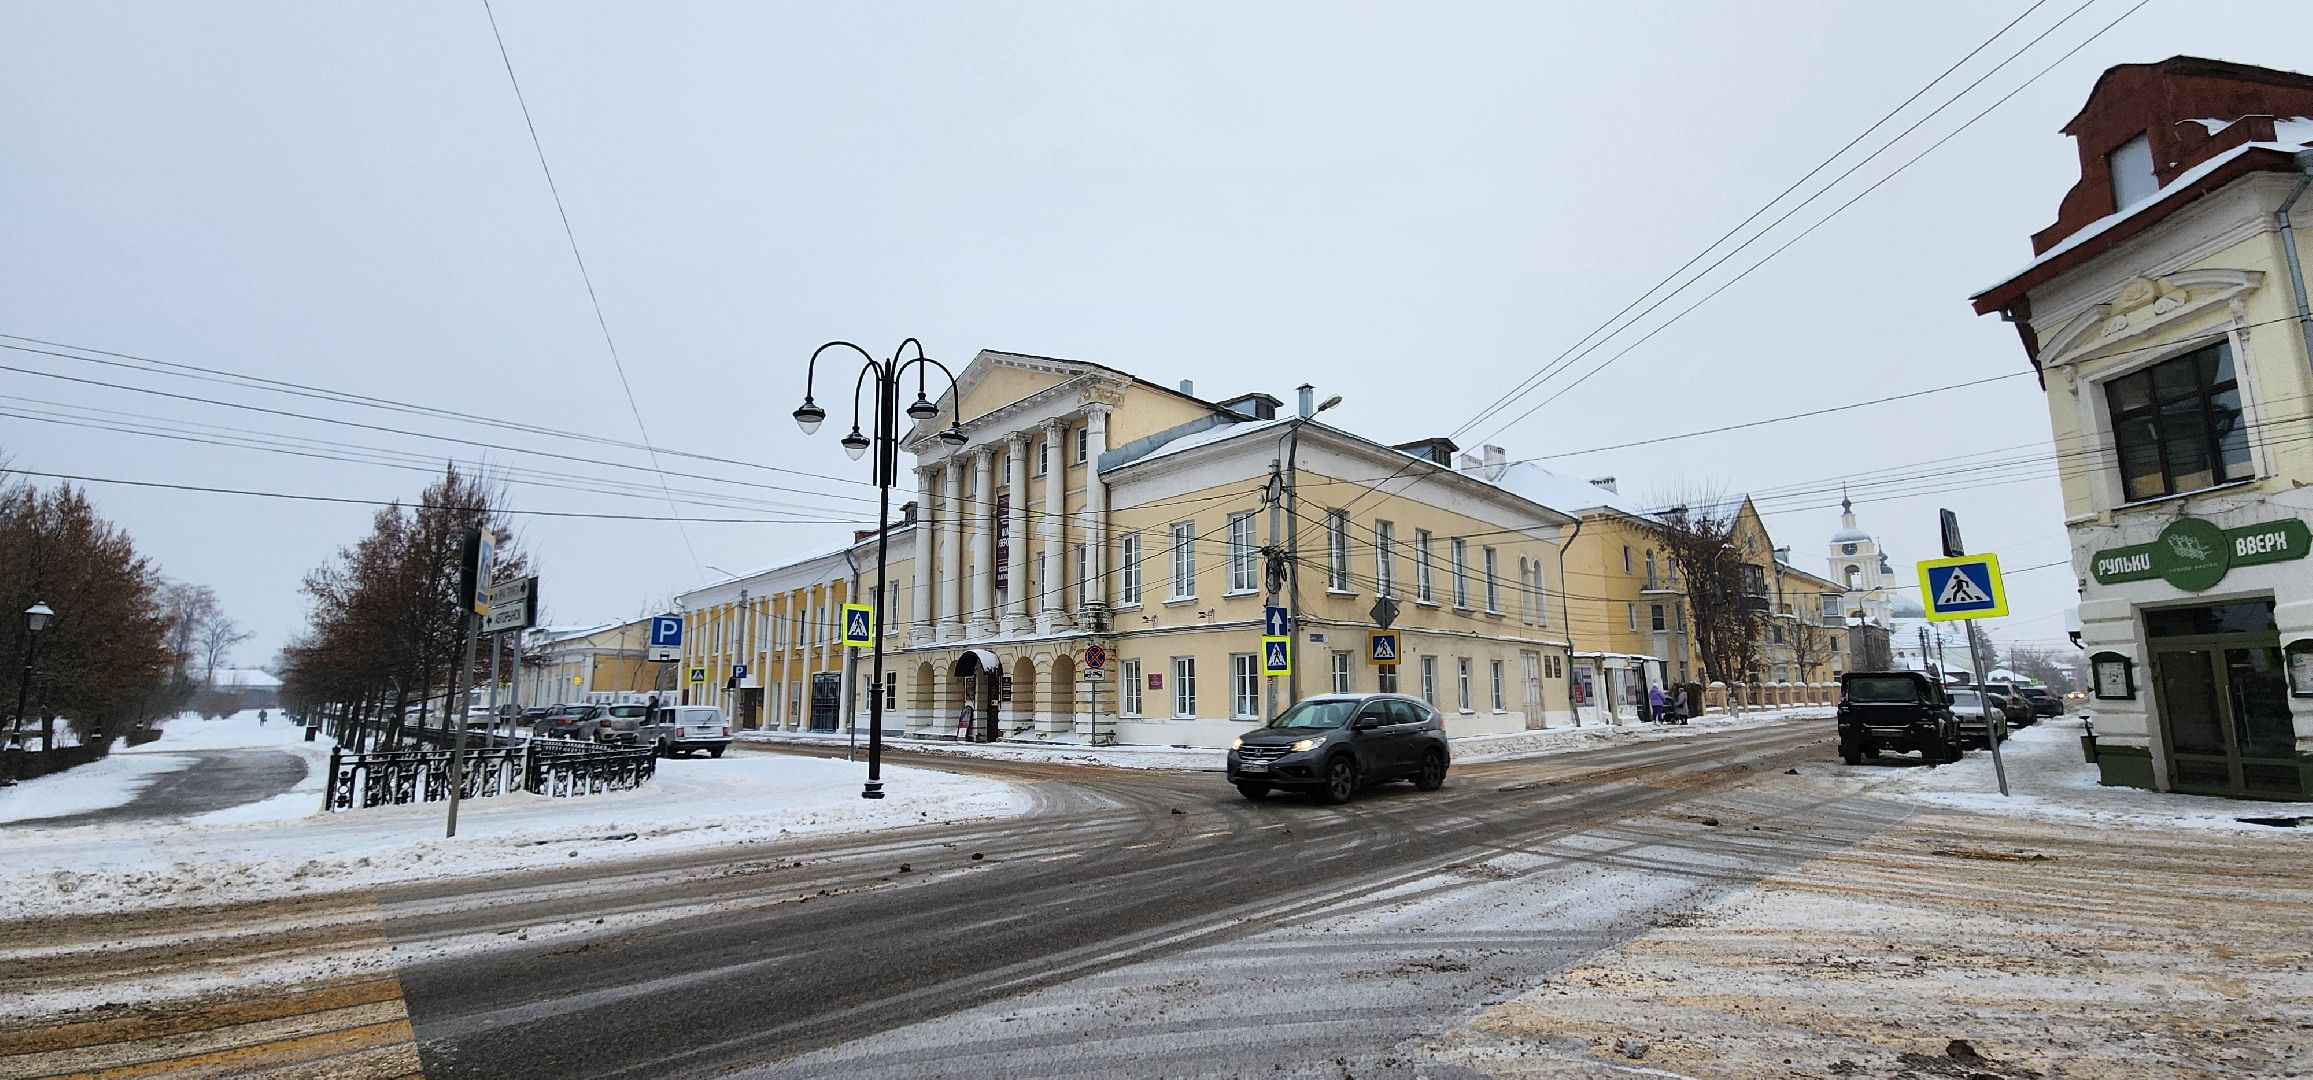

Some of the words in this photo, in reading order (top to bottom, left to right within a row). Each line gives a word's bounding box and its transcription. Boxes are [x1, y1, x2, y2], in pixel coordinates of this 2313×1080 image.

[2098, 552, 2150, 576] РУЛЬКИ
[2235, 530, 2288, 557] ВВЕРХ
[659, 619, 678, 643] P
[735, 666, 744, 678] P
